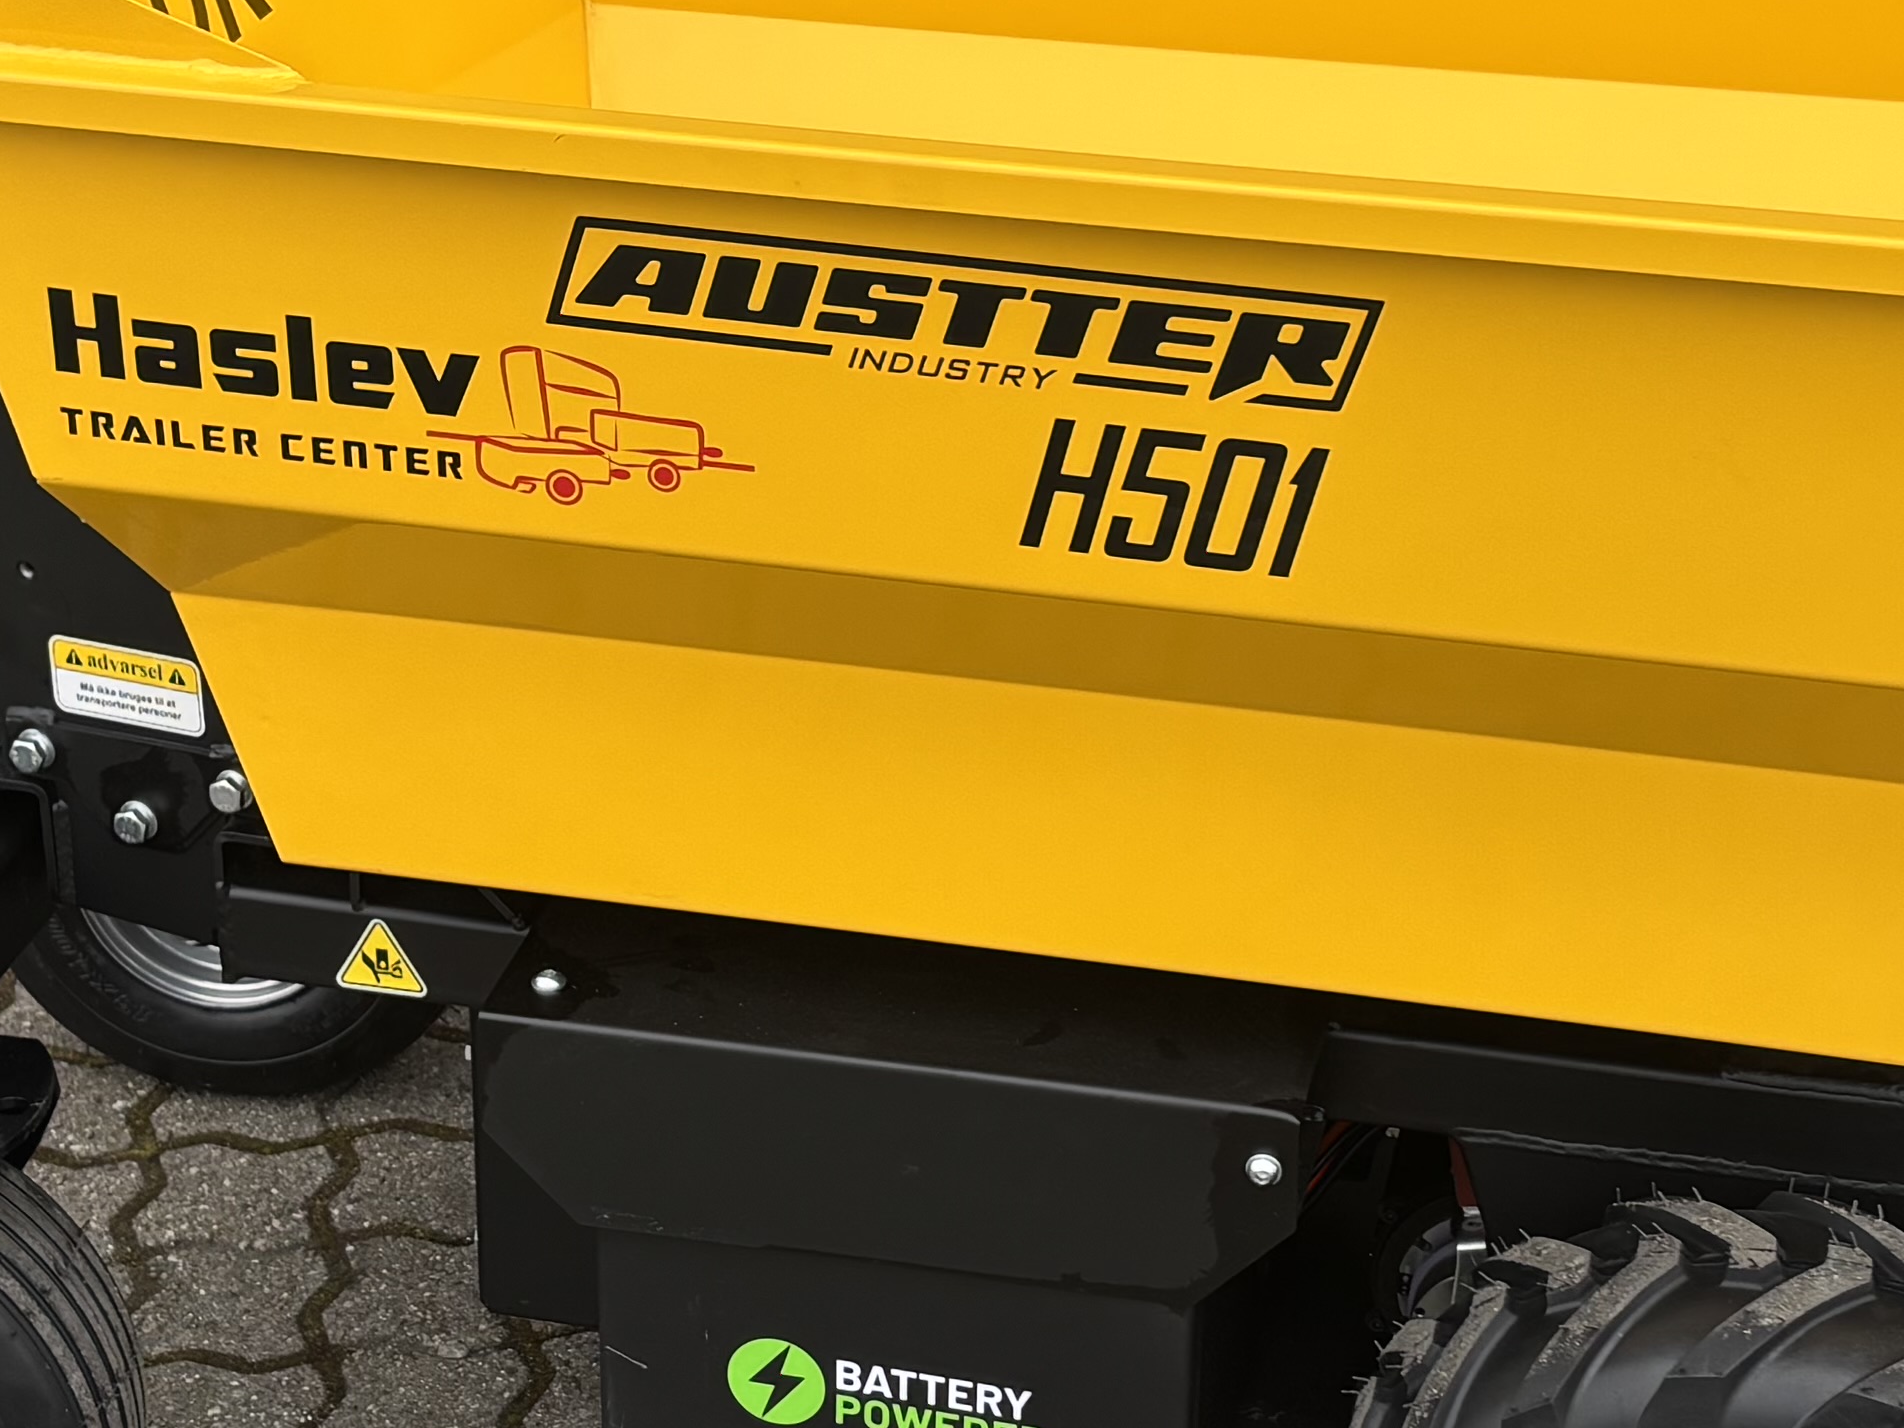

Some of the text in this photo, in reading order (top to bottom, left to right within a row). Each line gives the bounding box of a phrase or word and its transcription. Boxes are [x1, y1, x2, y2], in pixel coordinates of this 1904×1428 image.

[47, 287, 480, 417] Haslev
[575, 244, 1352, 401] AUSTTER
[848, 347, 1057, 390] INDUSTRY
[60, 408, 463, 480] TRAILER CENTER
[1019, 419, 1330, 578] H501
[88, 654, 163, 681] advarsel
[835, 1359, 1033, 1421] BATTERY
